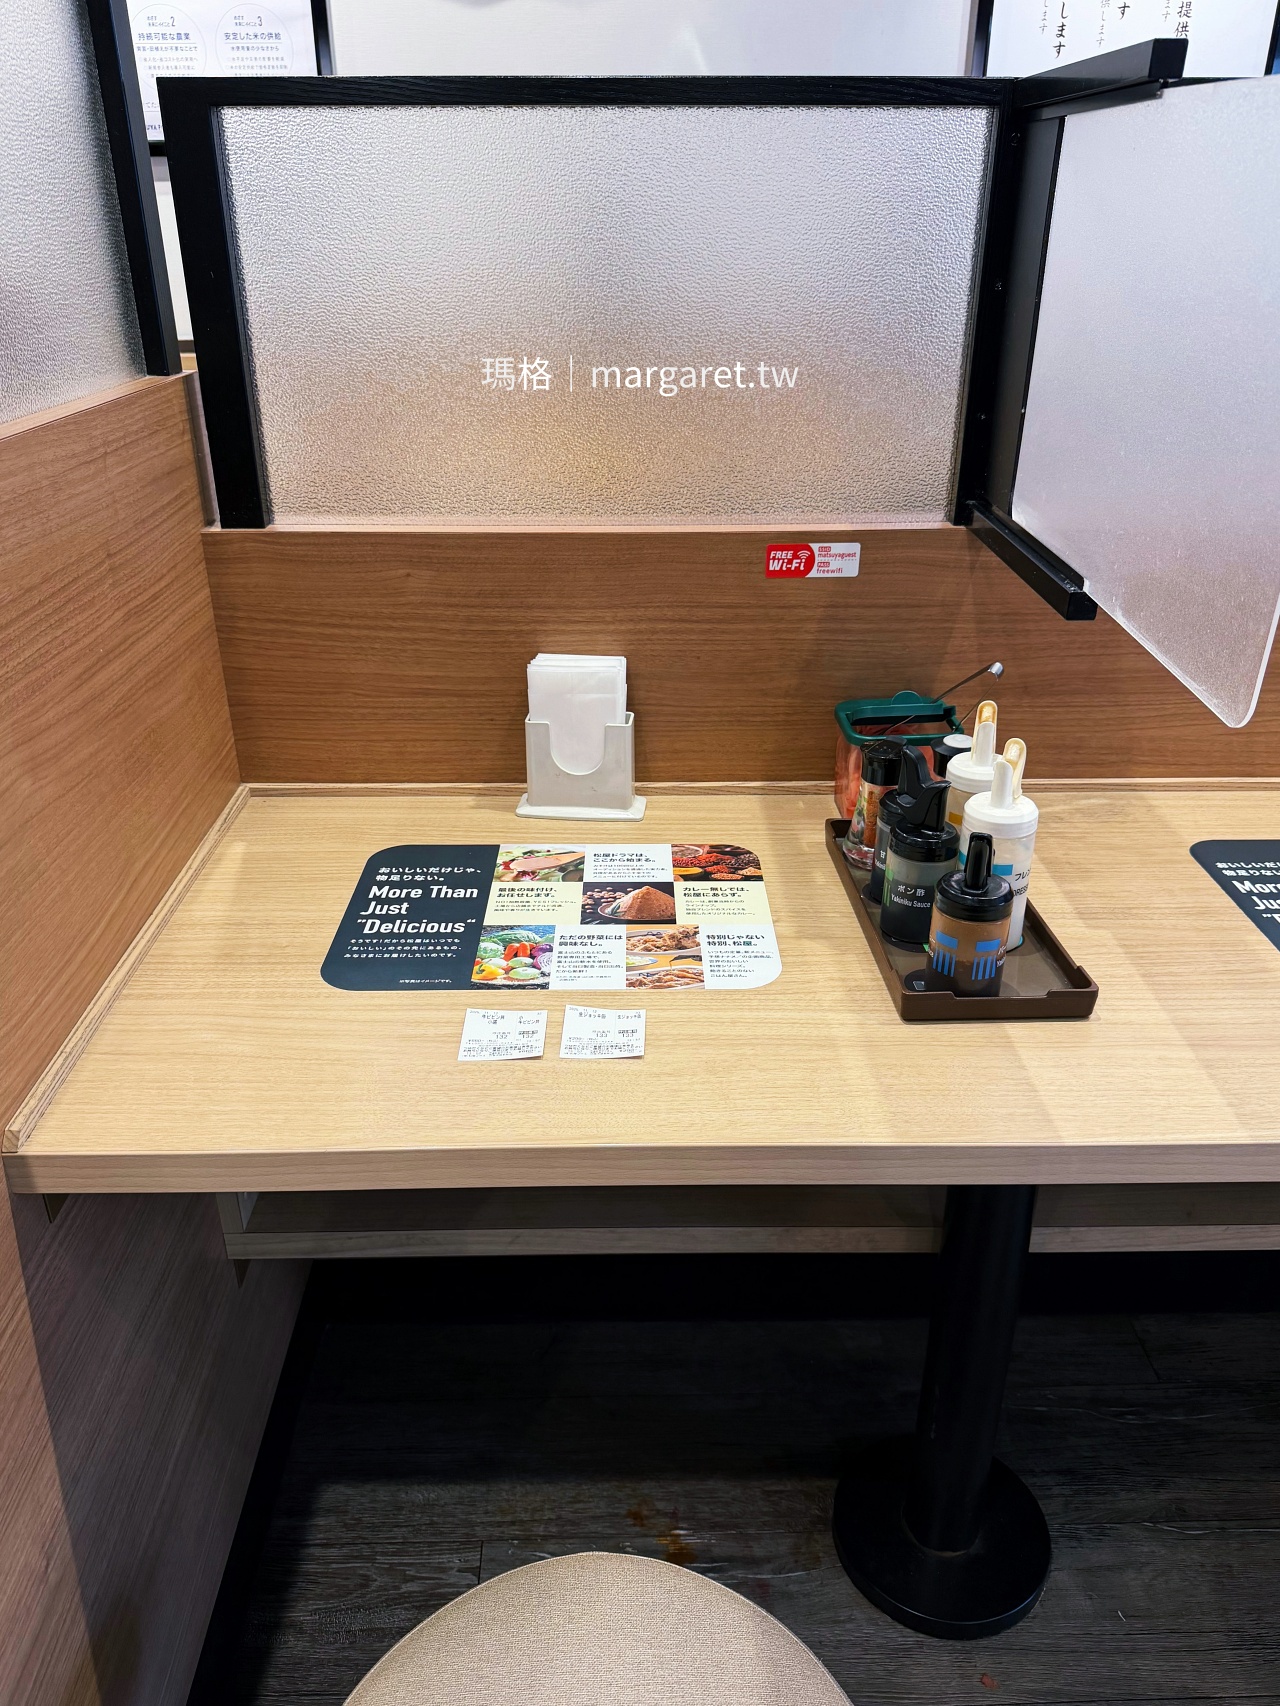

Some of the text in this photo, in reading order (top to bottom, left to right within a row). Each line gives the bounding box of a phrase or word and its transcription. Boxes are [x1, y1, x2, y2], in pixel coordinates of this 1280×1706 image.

[1117, 1, 1131, 20] す
[170, 16, 176, 27] 2
[257, 16, 263, 26] 3
[1174, 0, 1192, 38] 提供
[224, 32, 282, 40] 安定した米の供給
[1052, 1, 1069, 58] します
[138, 32, 191, 41] 持続可能な農業
[770, 551, 794, 559] FREE
[768, 559, 805, 571] Wi-Fi
[368, 886, 479, 899] More Than
[898, 884, 926, 897] ポン酢
[891, 893, 913, 906] Yakiniku
[360, 901, 410, 915] Just
